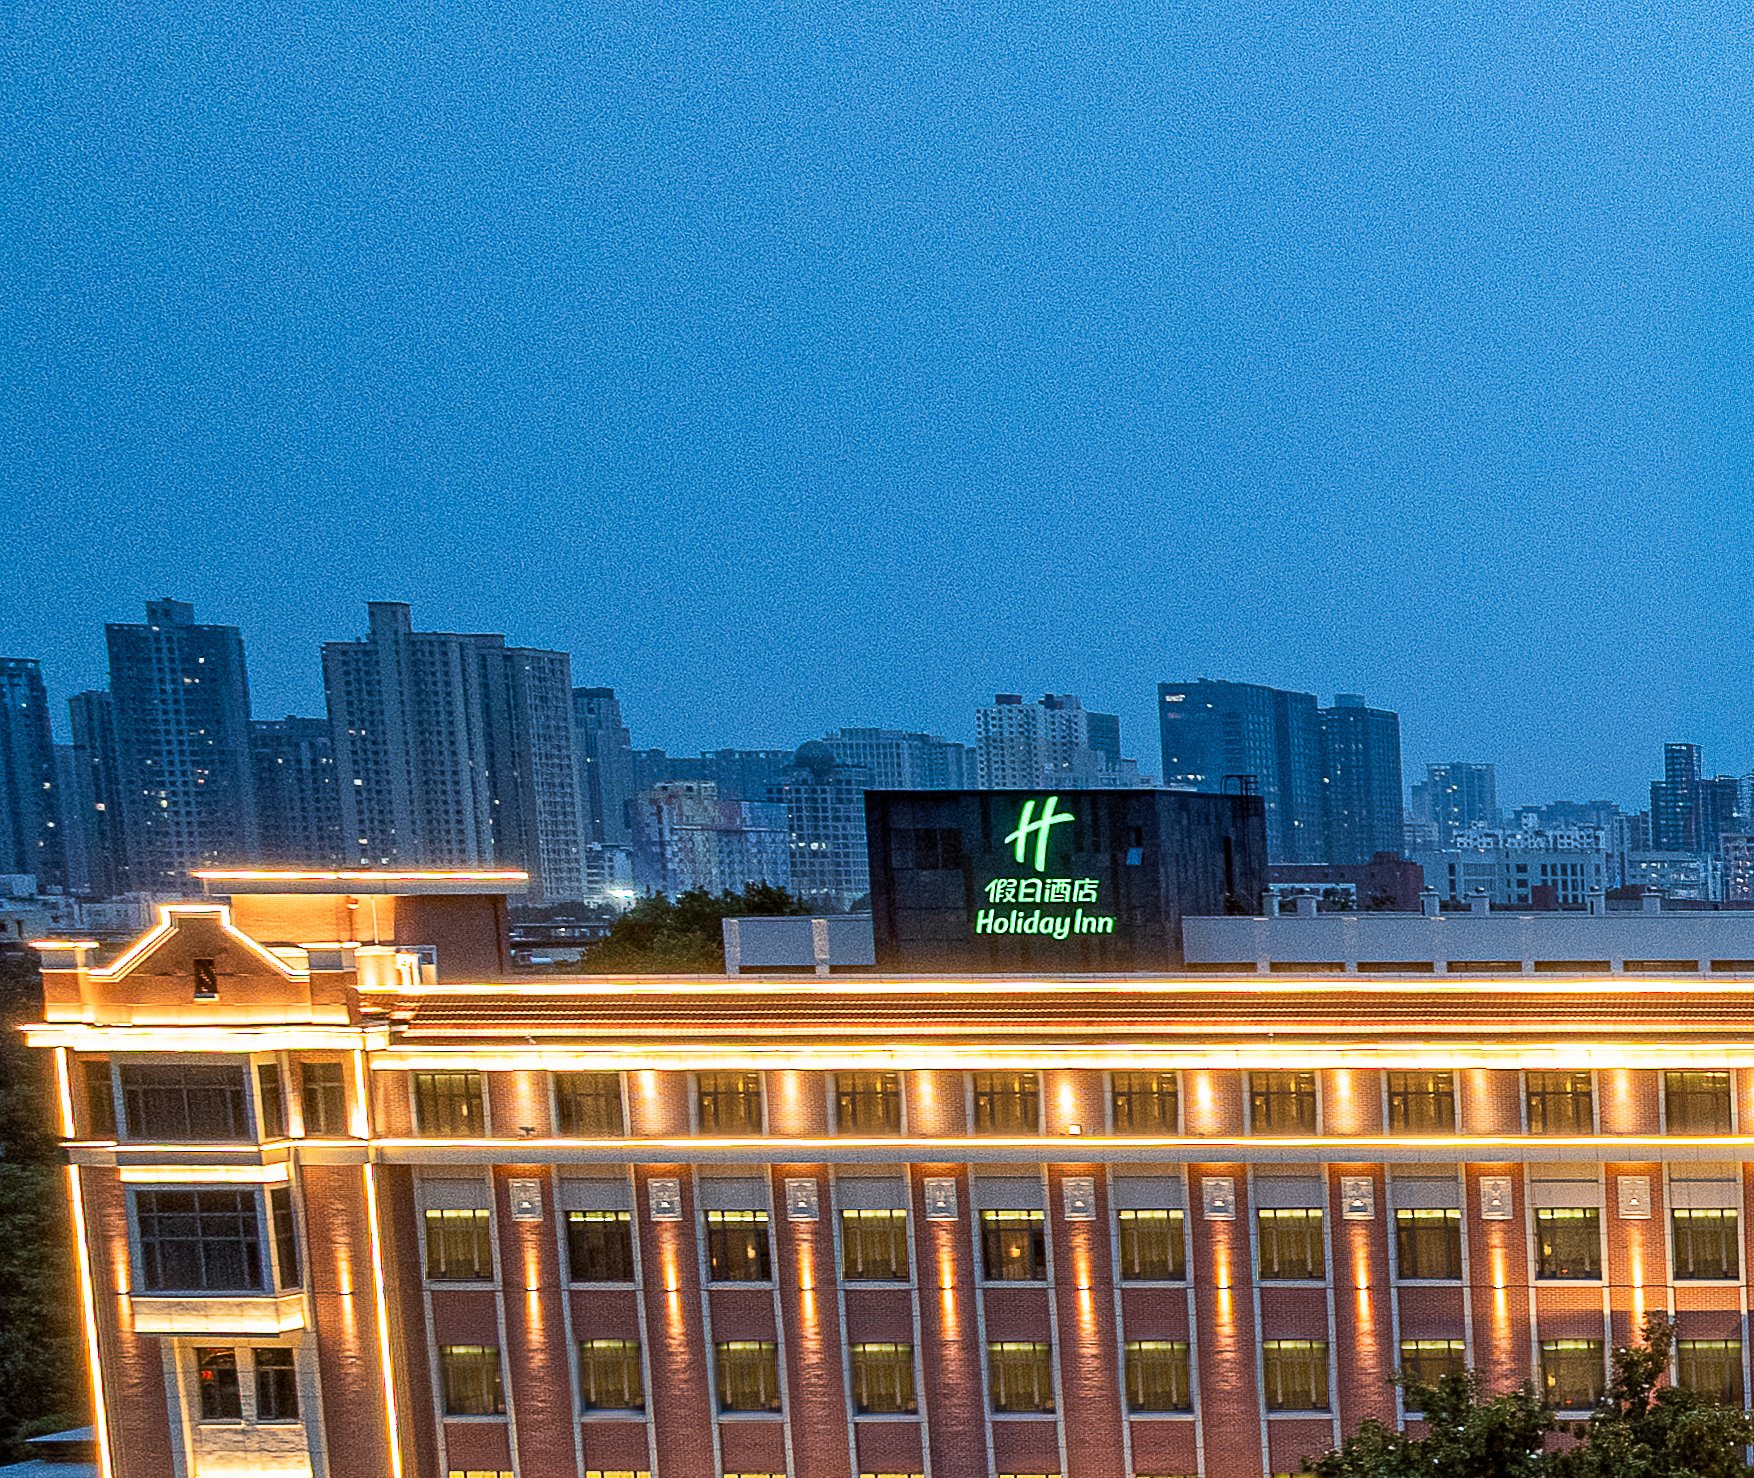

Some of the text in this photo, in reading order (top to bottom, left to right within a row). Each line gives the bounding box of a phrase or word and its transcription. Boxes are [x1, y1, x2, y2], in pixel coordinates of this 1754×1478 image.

[984, 878, 1099, 903] 假日酒店
[976, 909, 1114, 939] Holiday Inn
